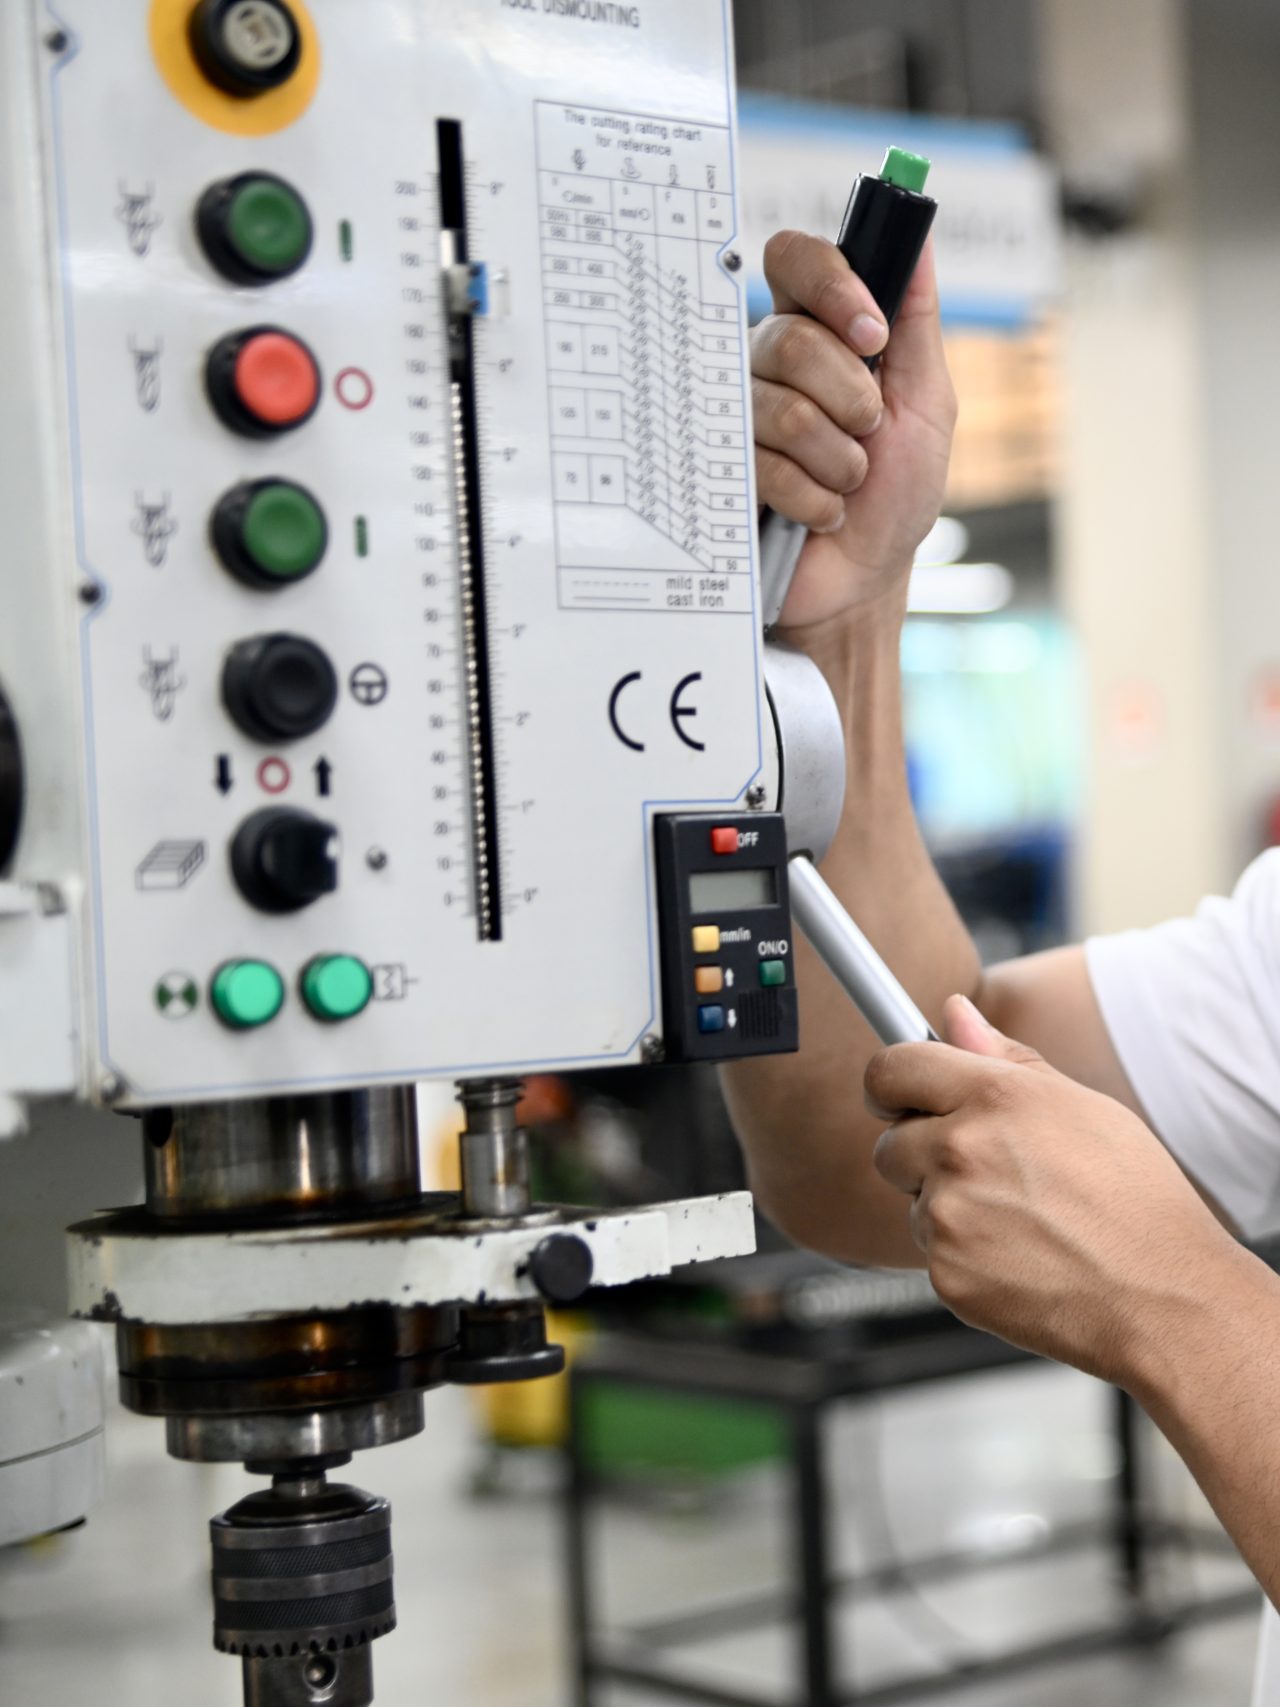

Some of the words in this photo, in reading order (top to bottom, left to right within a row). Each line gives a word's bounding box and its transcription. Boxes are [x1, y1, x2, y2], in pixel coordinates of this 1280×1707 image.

[564, 109, 585, 126] The
[591, 114, 630, 134] cutting
[635, 122, 667, 139] rating
[673, 127, 702, 141] chart
[595, 134, 612, 147] for
[719, 402, 730, 413] 25
[723, 497, 734, 508] 40
[725, 528, 736, 539] 45
[727, 559, 737, 571] 50
[666, 577, 693, 590] mild
[698, 577, 730, 591] steel
[667, 593, 693, 606] cast
[700, 594, 724, 607] iron
[608, 671, 706, 752] CE
[434, 821, 448, 835] 20
[736, 831, 759, 848] OFF
[438, 858, 450, 871] 10
